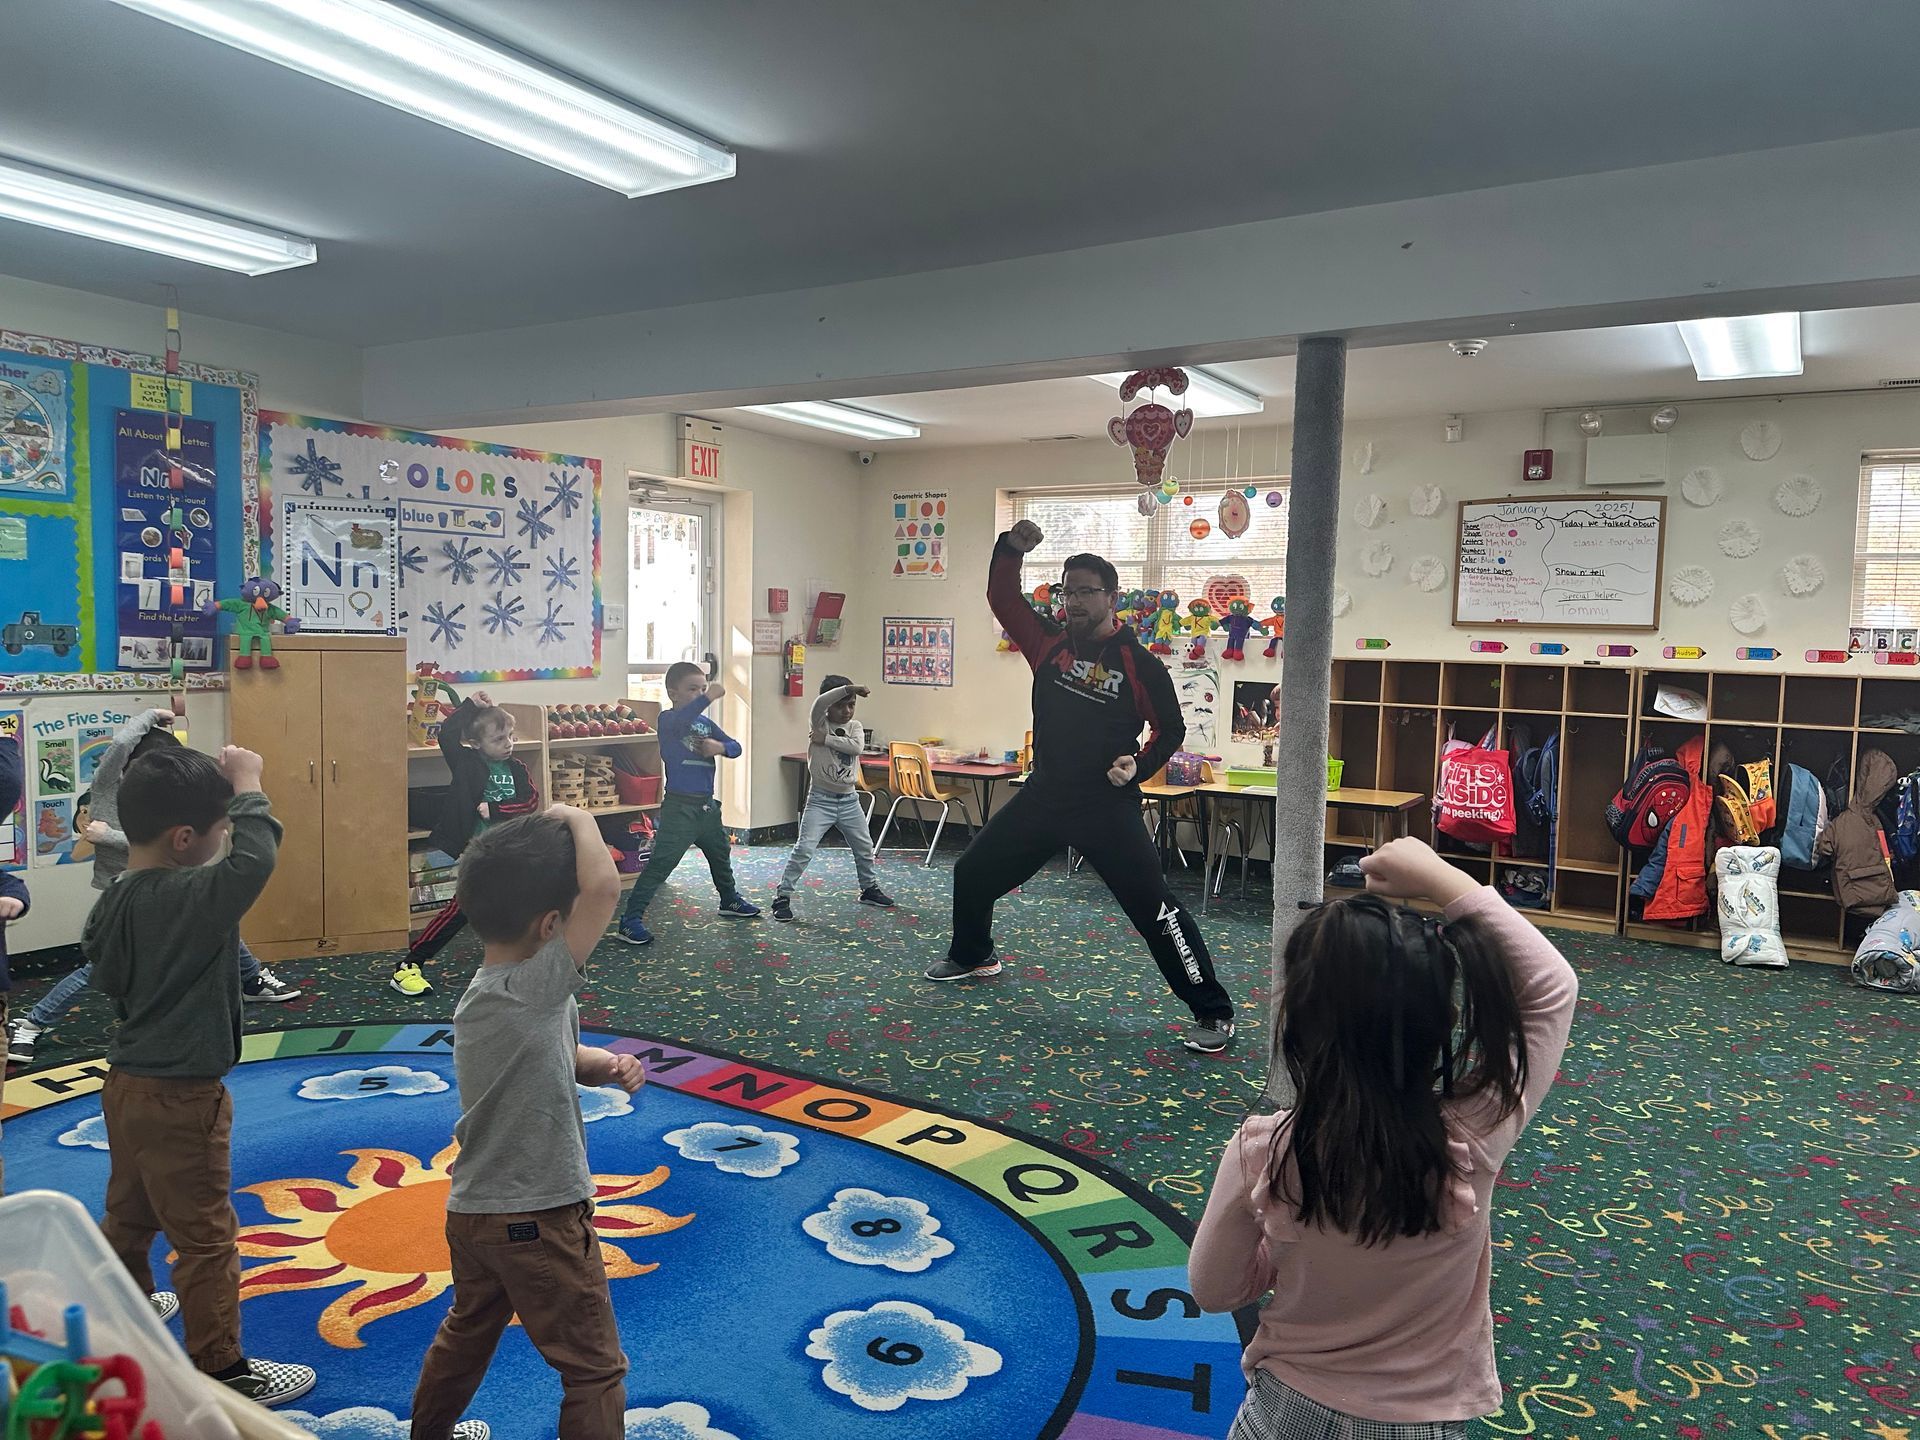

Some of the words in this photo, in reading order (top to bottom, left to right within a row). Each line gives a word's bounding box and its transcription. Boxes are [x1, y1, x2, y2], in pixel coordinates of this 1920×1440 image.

[119, 427, 133, 437] All
[134, 429, 163, 440] About
[691, 444, 720, 478] EXIT
[127, 489, 154, 500] Listen
[156, 493, 165, 501] to
[402, 508, 434, 523] blue
[1498, 504, 1548, 516] January
[1595, 502, 1634, 513] 2025!
[1561, 521, 1583, 529] Today
[1604, 520, 1630, 528] talked
[1484, 530, 1506, 538] Circle
[1555, 568, 1577, 576] Show
[1562, 592, 1590, 601] Special
[1594, 592, 1618, 600] Helper
[138, 612, 157, 621] Find
[158, 613, 172, 621] the
[174, 614, 200, 622] Letter
[1555, 604, 1610, 621] Tommy
[1194, 617, 1204, 629] K
[51, 628, 66, 641] 12
[1851, 637, 1861, 649] A
[1877, 638, 1888, 650] B
[1901, 638, 1912, 650] C
[33, 718, 65, 737] The
[67, 712, 99, 728] Five
[86, 729, 106, 738] Sight
[45, 741, 67, 749] Smell
[41, 800, 65, 809] Touch
[317, 1029, 356, 1052] J
[634, 1047, 694, 1074] M
[31, 1065, 110, 1094] H
[358, 1076, 389, 1091] 5
[709, 1071, 784, 1101] N
[803, 1098, 871, 1124] O
[896, 1123, 967, 1147] P
[716, 1137, 764, 1153] 7
[1002, 1162, 1079, 1205] Q
[851, 1217, 902, 1239] 8
[1070, 1219, 1154, 1259] R
[1111, 1287, 1201, 1321] S
[866, 1335, 924, 1366] 9
[1115, 1362, 1212, 1415] T
